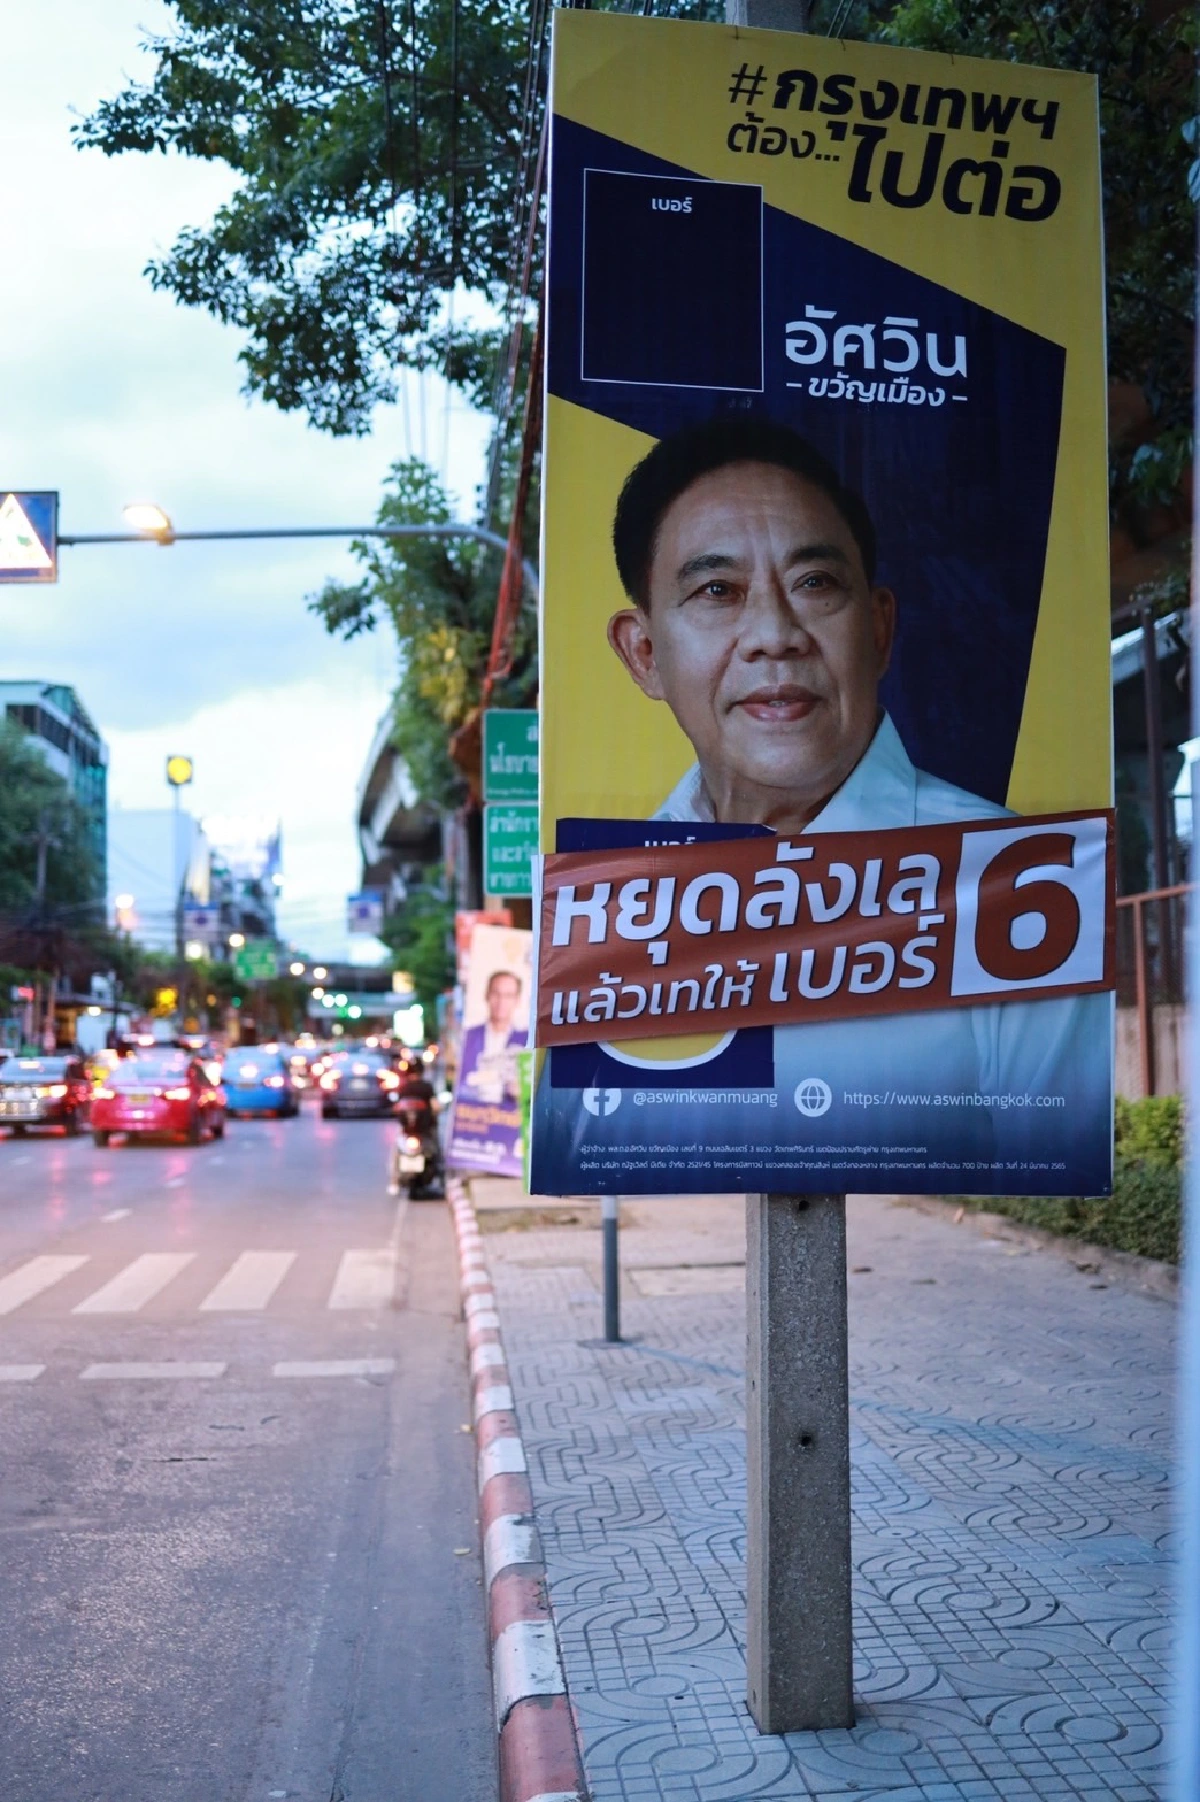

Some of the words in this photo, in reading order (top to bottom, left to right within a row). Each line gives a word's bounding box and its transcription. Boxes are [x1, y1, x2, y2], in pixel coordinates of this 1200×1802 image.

[728, 62, 1060, 142] #กรุงเทพฯ
[727, 111, 840, 162] ต้อง...
[848, 122, 1062, 222] ไปต่อ
[652, 197, 693, 213] เบอร์
[785, 305, 967, 379] อัศวิน
[808, 372, 946, 407] ขวัญเมือง
[552, 841, 941, 965] หยุดลังเล
[974, 832, 1081, 981] 6
[632, 1089, 778, 1108] @aswinkwanmuang
[844, 1091, 1065, 1109] https://www.aswinbangkok.com
